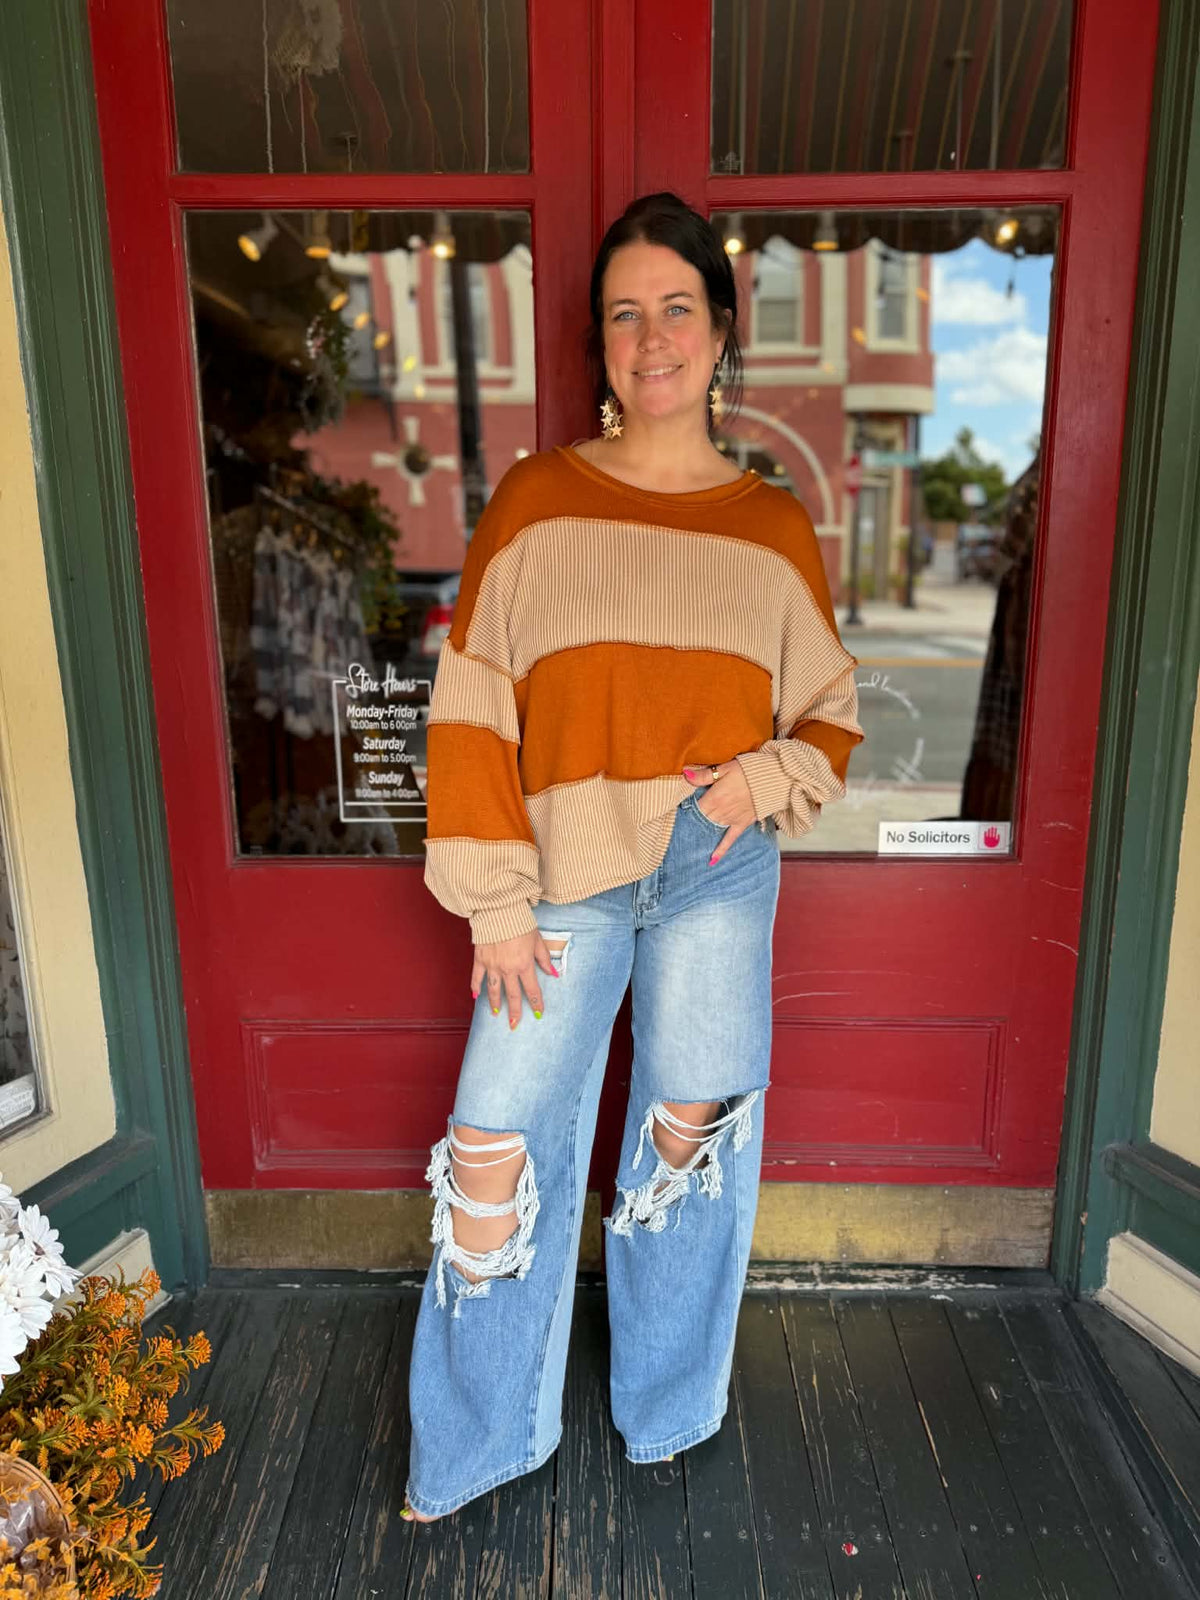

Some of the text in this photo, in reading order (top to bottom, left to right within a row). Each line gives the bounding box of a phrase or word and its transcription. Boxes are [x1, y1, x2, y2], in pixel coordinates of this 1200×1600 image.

[345, 662, 417, 698] Store Hours
[346, 705, 418, 720] Monday-Friday
[381, 720, 389, 730] to
[389, 720, 417, 731] 600pm
[363, 737, 406, 752] Saturday
[381, 752, 389, 763] to
[368, 771, 404, 787] Sunday
[886, 830, 971, 844] No Solicitors
